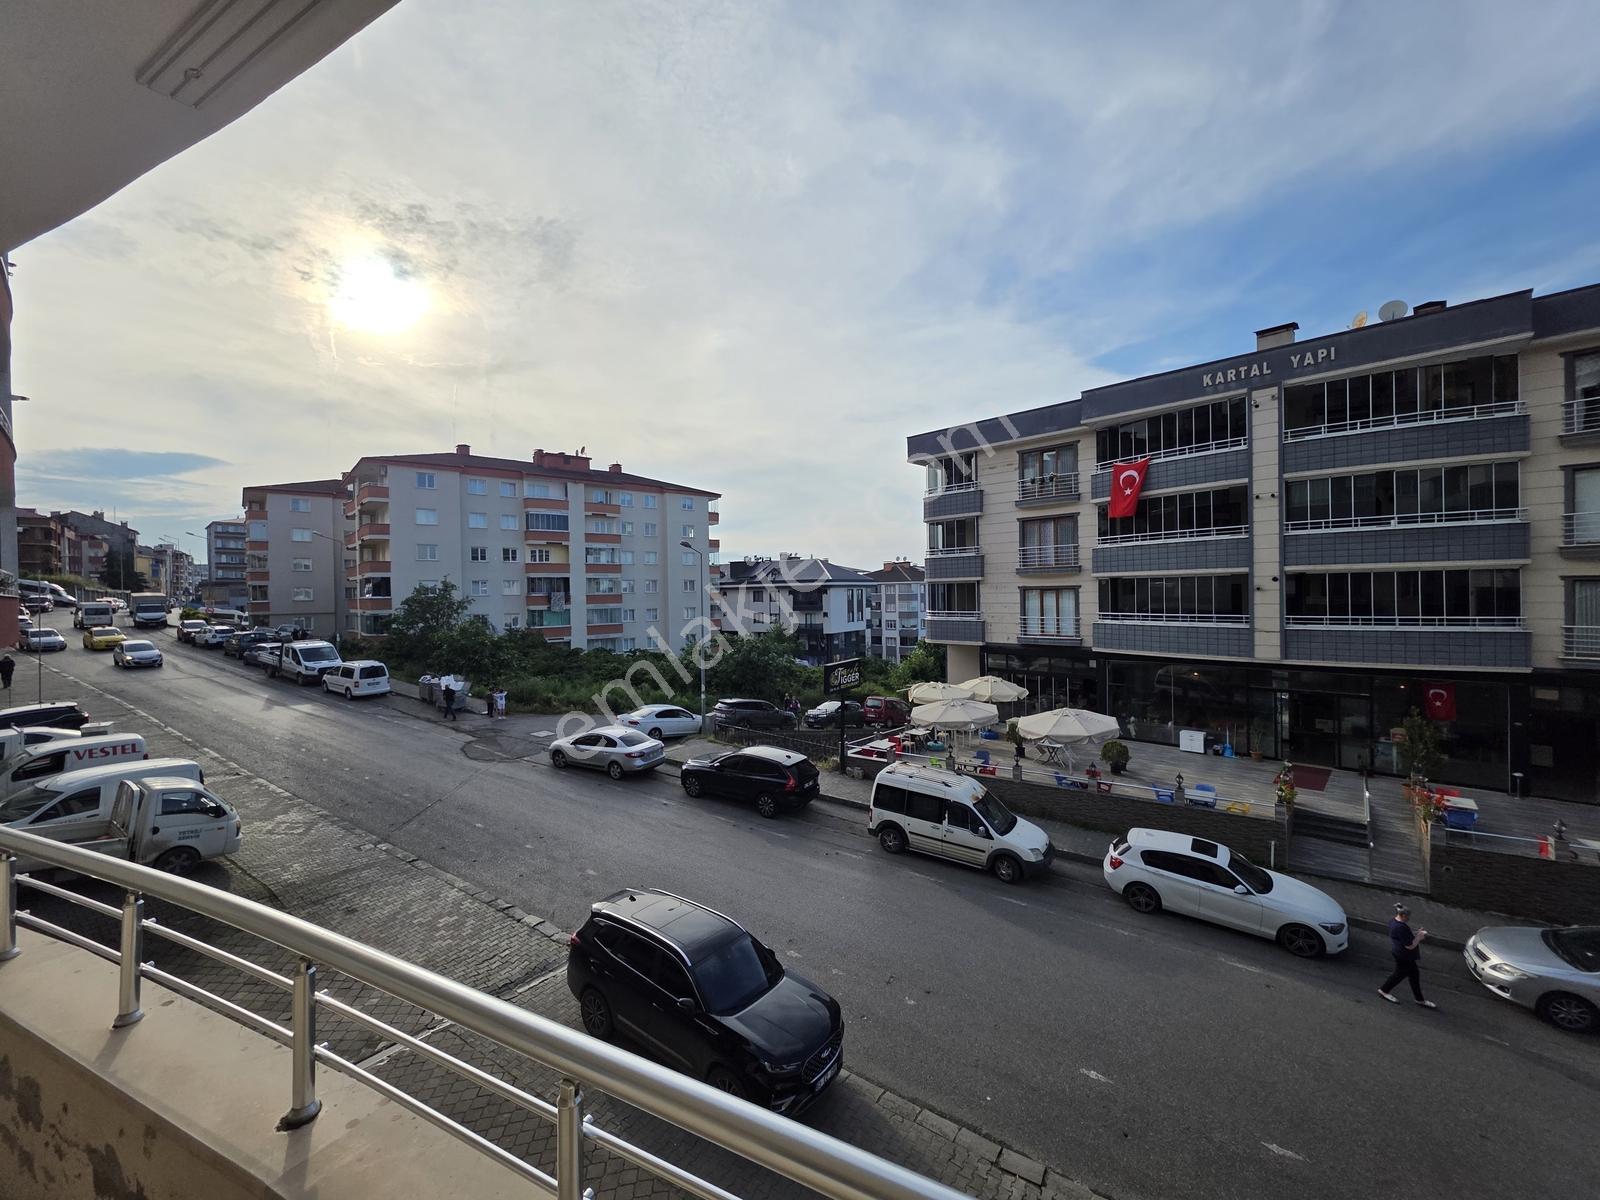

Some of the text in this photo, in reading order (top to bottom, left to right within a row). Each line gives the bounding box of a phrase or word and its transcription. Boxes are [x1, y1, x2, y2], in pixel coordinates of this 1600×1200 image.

[1202, 346, 1336, 387] KARTAL YAPI
[73, 743, 141, 761] VESTEL
